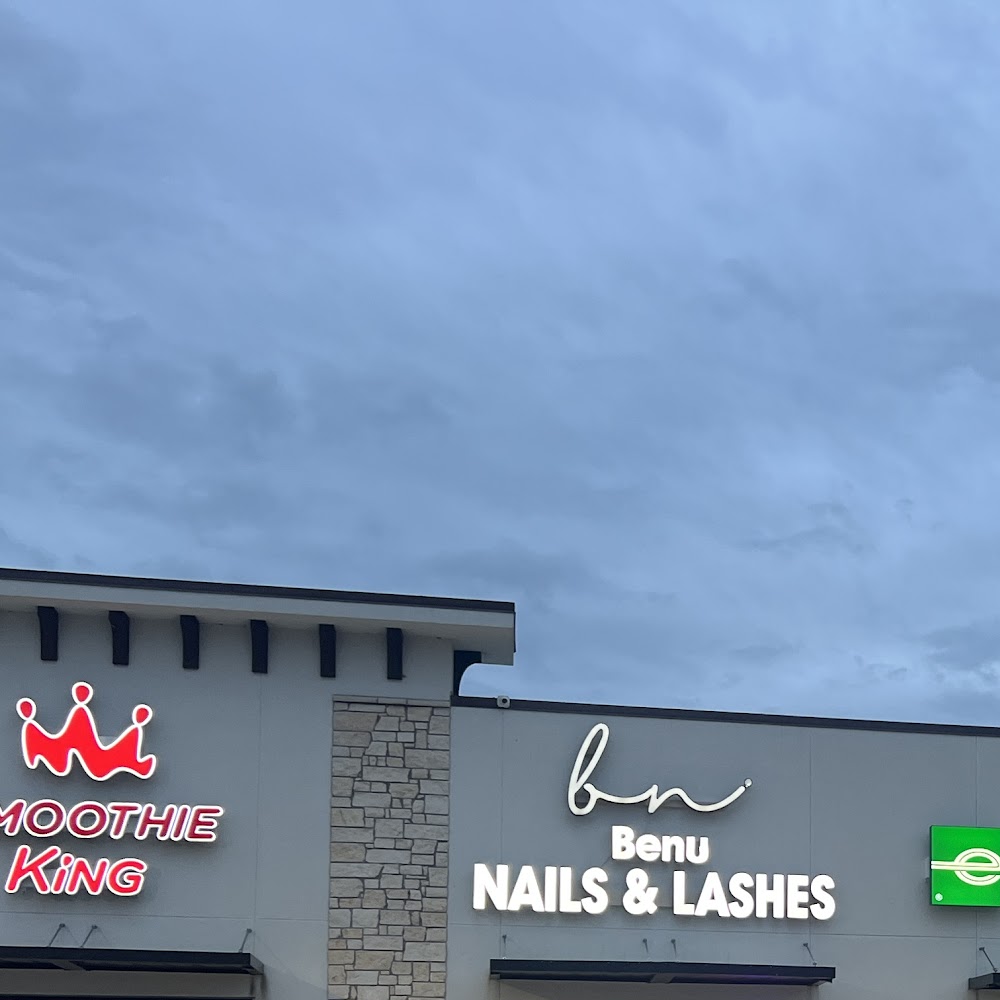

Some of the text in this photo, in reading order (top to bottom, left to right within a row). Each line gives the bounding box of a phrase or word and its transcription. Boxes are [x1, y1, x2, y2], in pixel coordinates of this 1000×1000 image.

[611, 825, 710, 864] Benu
[472, 863, 836, 921] NAILS & LASHES
